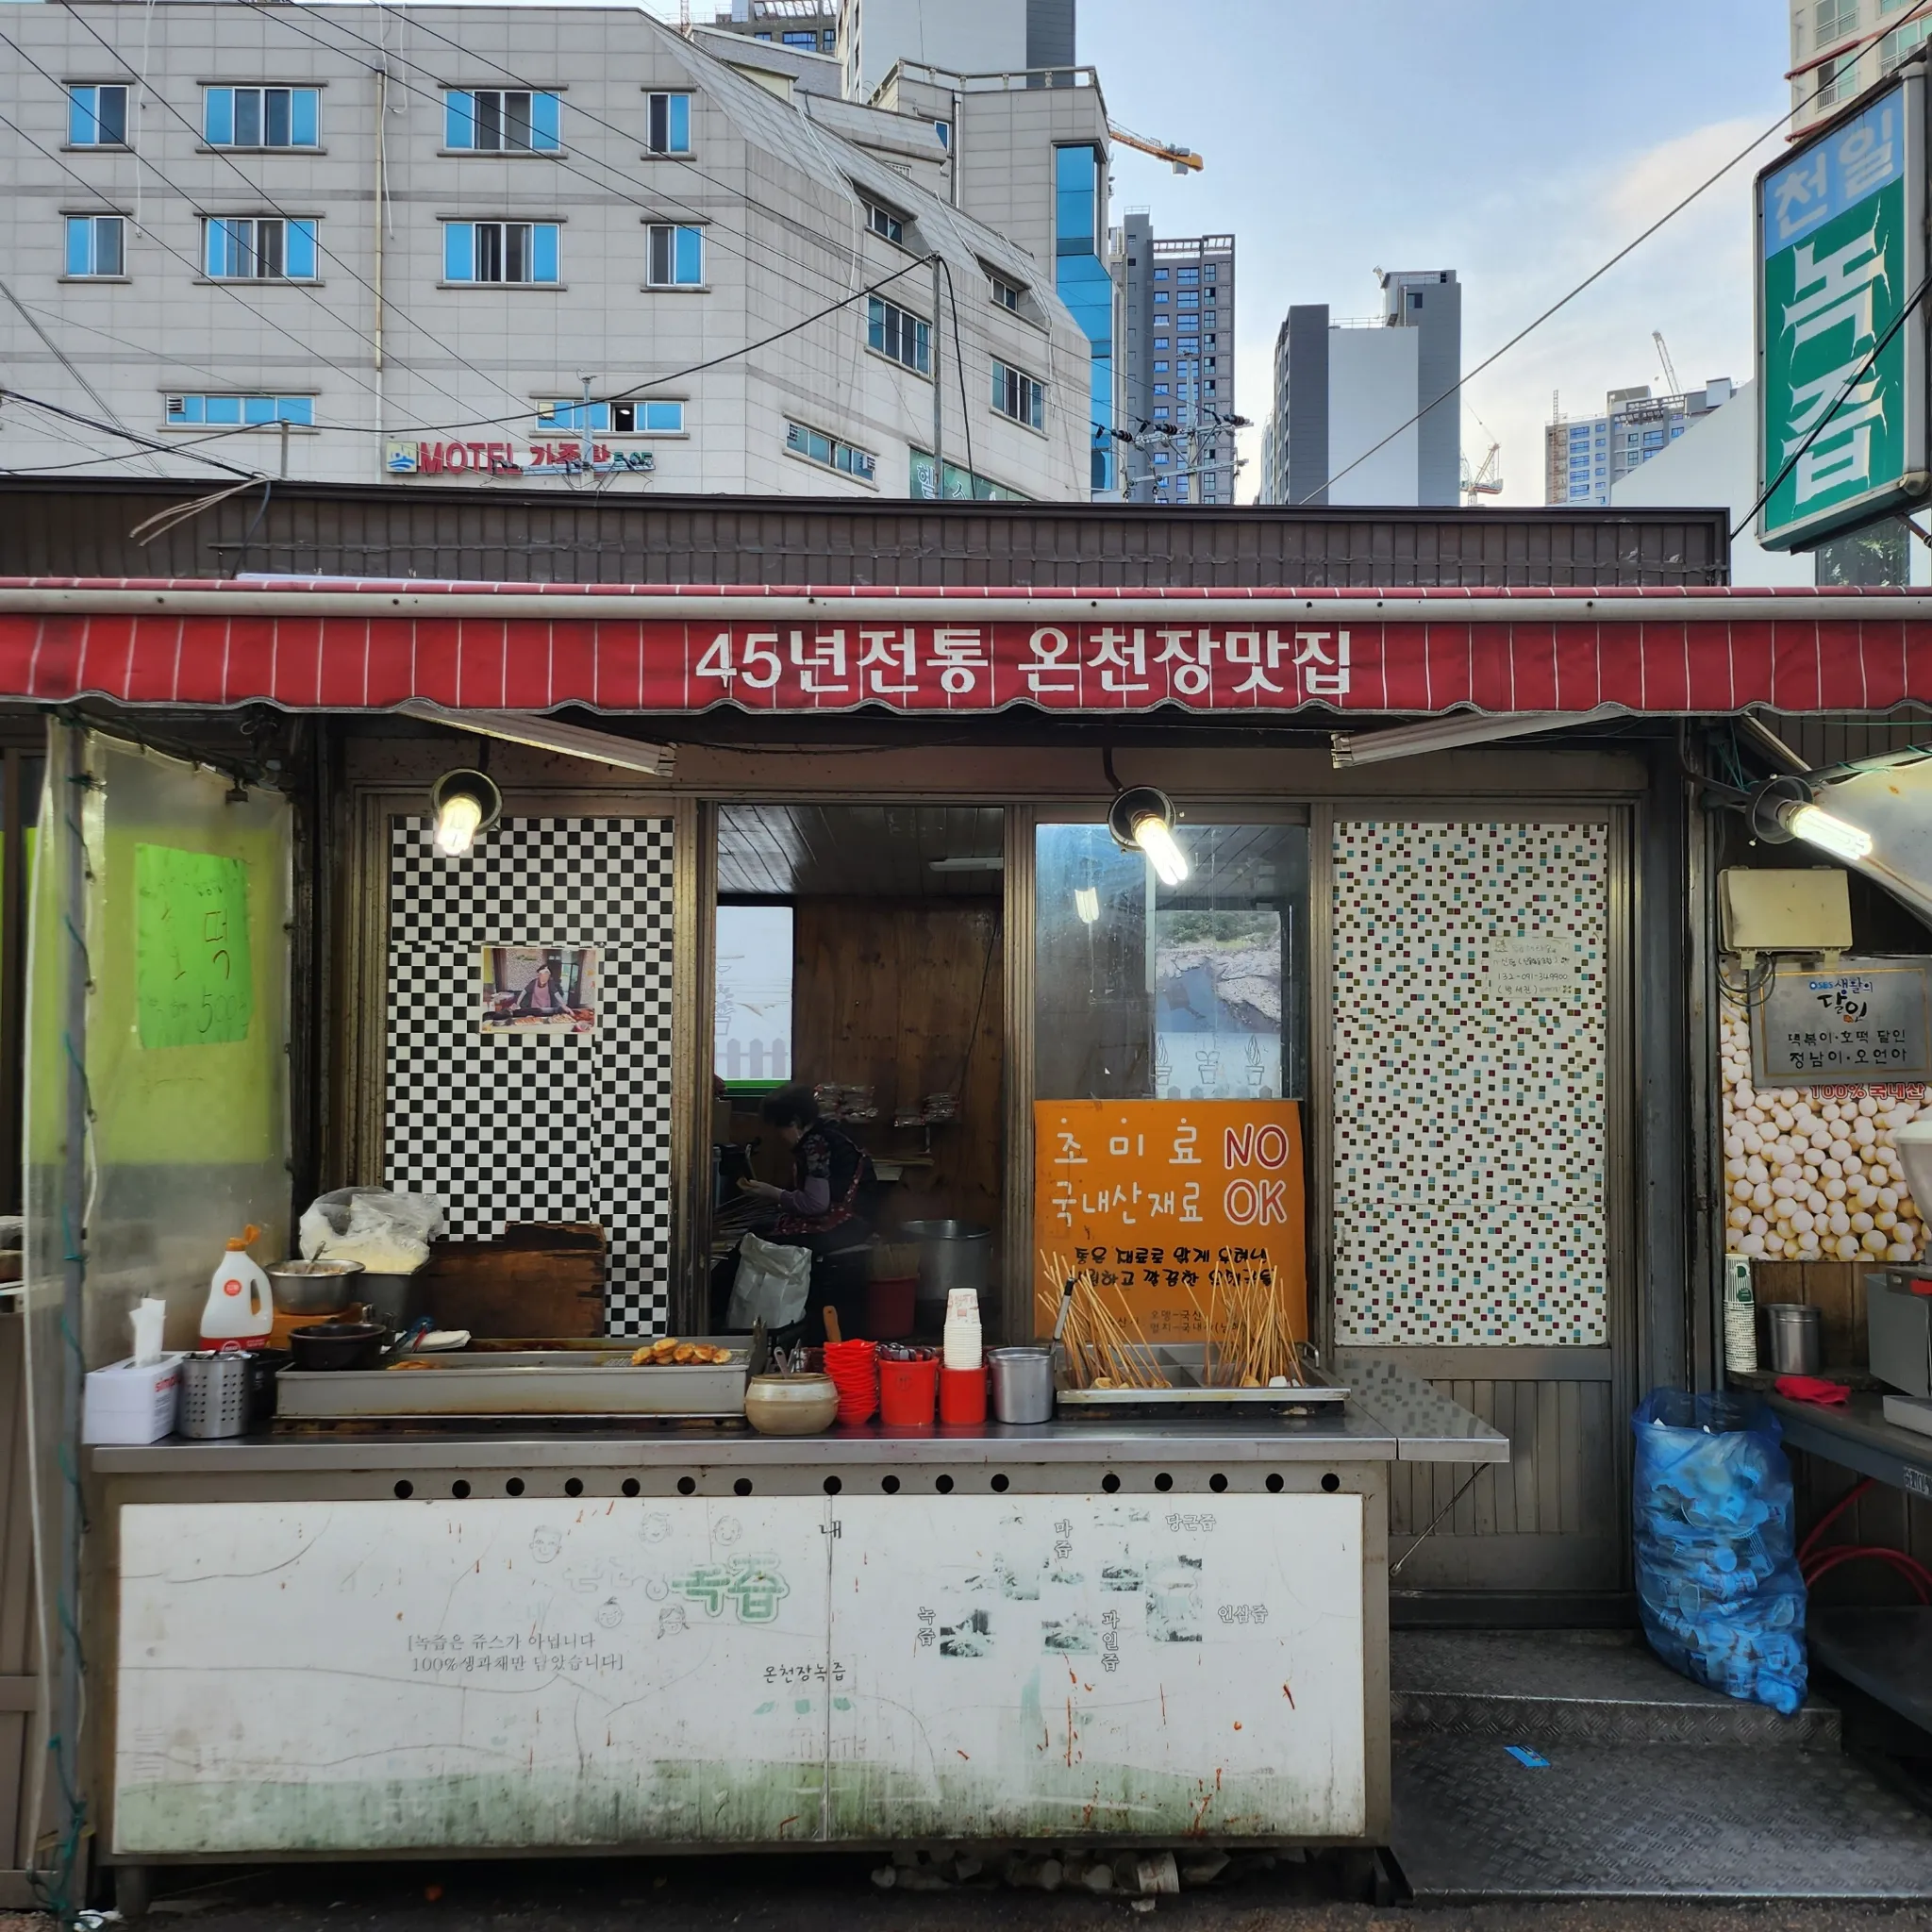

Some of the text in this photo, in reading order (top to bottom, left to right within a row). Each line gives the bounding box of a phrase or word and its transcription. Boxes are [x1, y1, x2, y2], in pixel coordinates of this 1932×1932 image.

[1774, 108, 1894, 240] 천일
[1779, 197, 1890, 516] 녹즙
[419, 441, 523, 475] MOTEL
[695, 627, 1351, 696] 45년전통 온천장맛집
[1834, 976, 1874, 995] 생활의
[1817, 991, 1868, 1023] 달인
[1876, 1028, 1906, 1044] 달인
[1809, 1083, 1925, 1101] 100% 국내산
[1224, 1123, 1289, 1170] NO
[1224, 1178, 1288, 1225] OK
[1165, 1513, 1217, 1532] 당근즙
[918, 1607, 936, 1647] 녹즙
[1217, 1605, 1269, 1624] 인삼즙
[472, 1633, 522, 1651] 쥬스가
[528, 1632, 597, 1650] 아닙니다
[1102, 1611, 1120, 1673] 과일즙
[763, 1662, 846, 1684] 온천장녹즙
